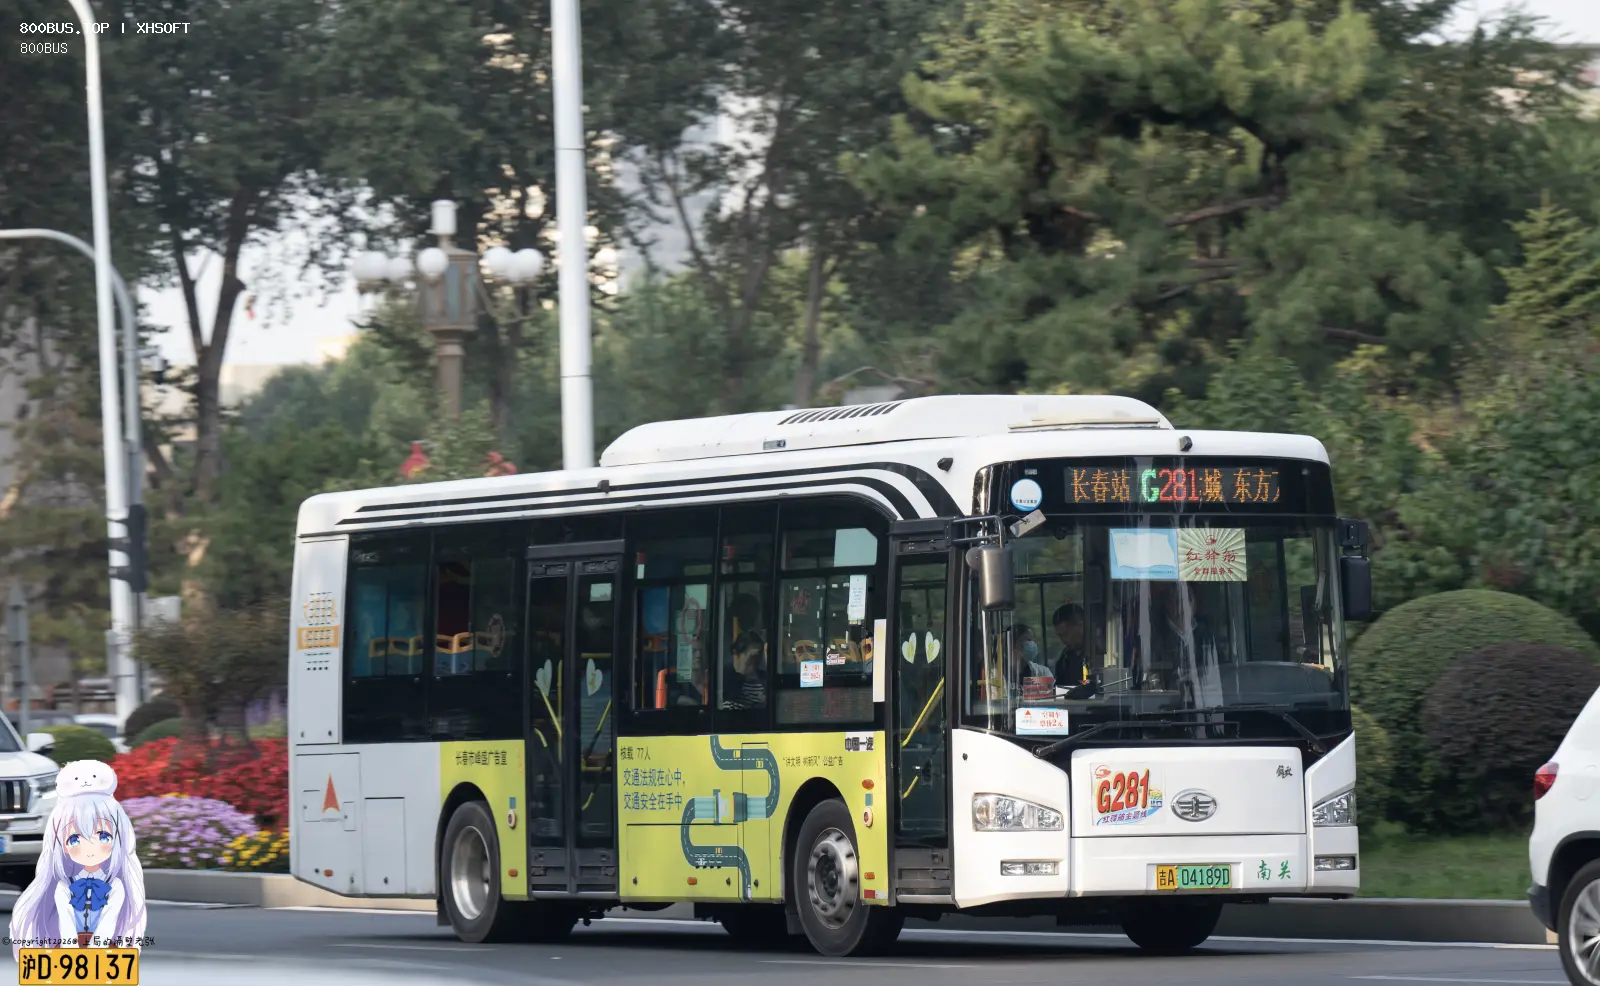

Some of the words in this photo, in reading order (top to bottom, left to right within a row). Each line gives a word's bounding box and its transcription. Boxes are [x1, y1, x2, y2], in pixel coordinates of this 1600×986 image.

[1071, 468, 1130, 502] 长春站
[1141, 468, 1200, 502] G281
[637, 746, 651, 761] 77人
[844, 736, 875, 752] 中国一汽
[823, 754, 844, 767] 公益广告
[1097, 767, 1149, 814] G281
[623, 791, 683, 811] 交通安全在手中
[1181, 868, 1230, 886] 04189D
[1257, 859, 1292, 881] 南关
